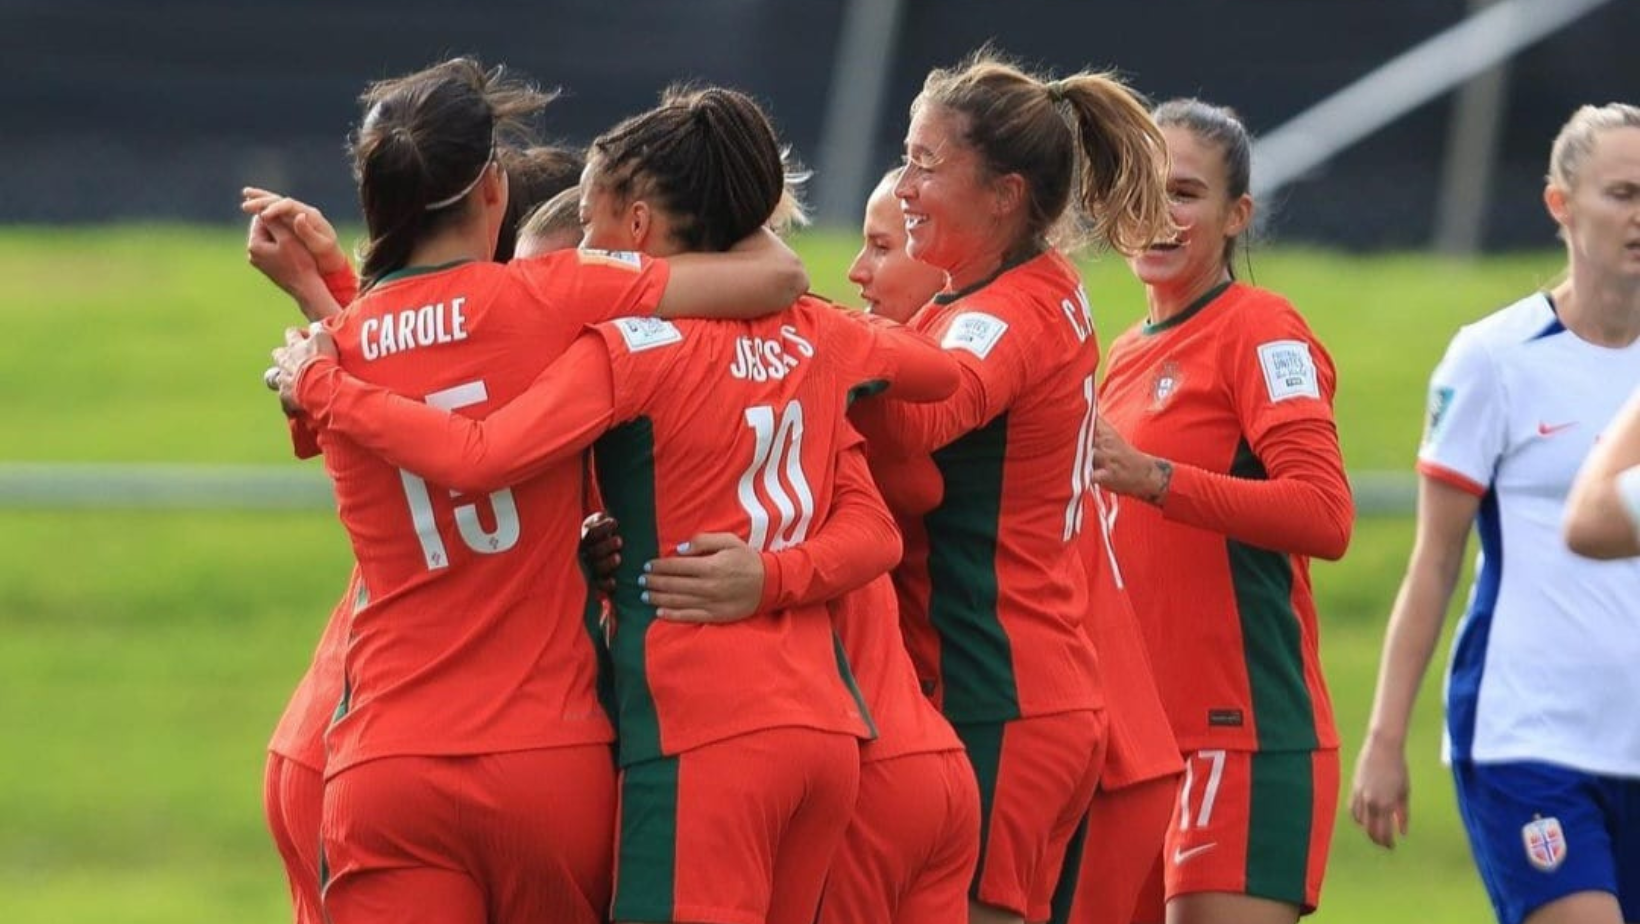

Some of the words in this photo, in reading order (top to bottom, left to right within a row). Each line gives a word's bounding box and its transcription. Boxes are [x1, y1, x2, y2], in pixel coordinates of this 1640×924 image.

[361, 297, 467, 361] CAROLE
[738, 400, 814, 553] 10
[1180, 750, 1226, 832] 17
